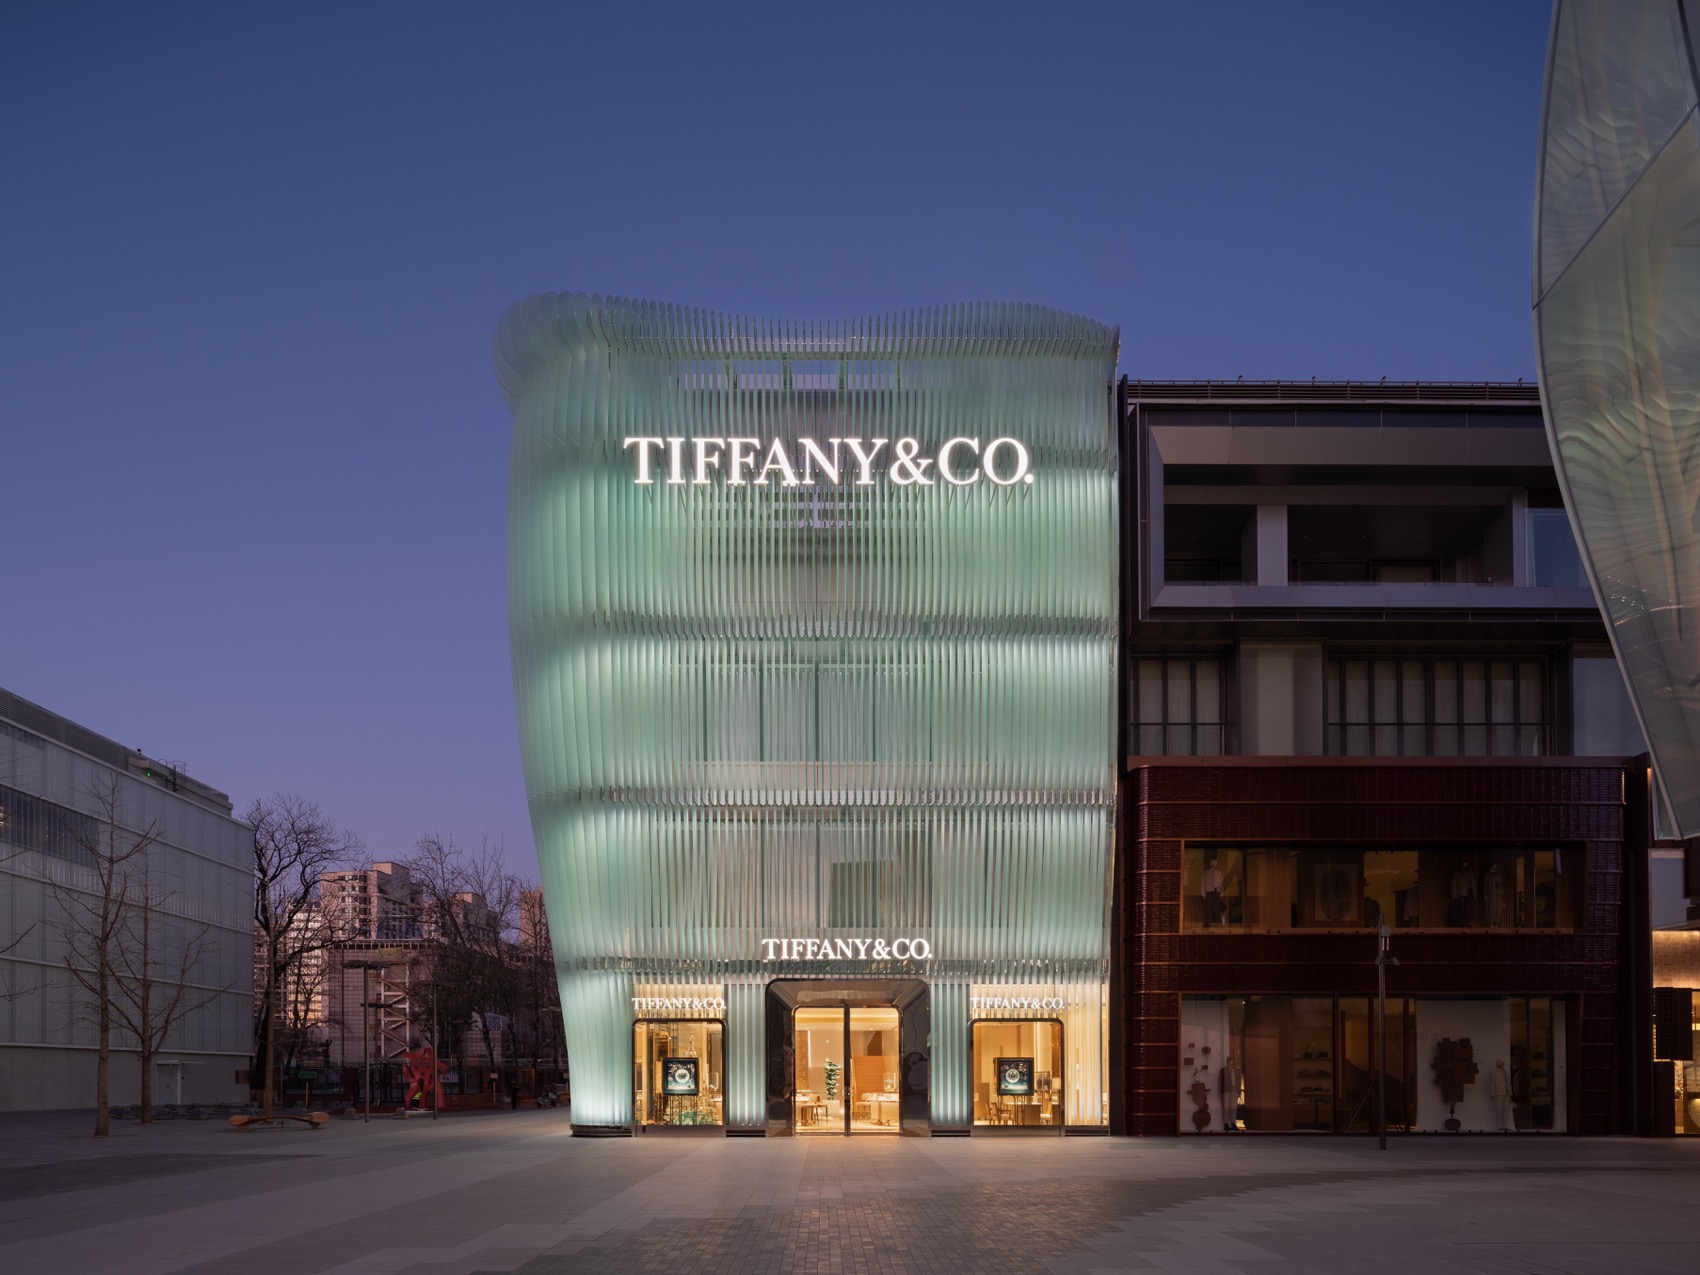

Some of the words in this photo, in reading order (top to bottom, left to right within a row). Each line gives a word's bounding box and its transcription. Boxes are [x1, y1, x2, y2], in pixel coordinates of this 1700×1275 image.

[623, 437, 1034, 485] TIFFANY&CO.
[762, 938, 932, 960] TIFFANY&CO.
[631, 997, 726, 1010] TIFFANY&CO.
[970, 997, 1065, 1010] TIFFANY&CO.
